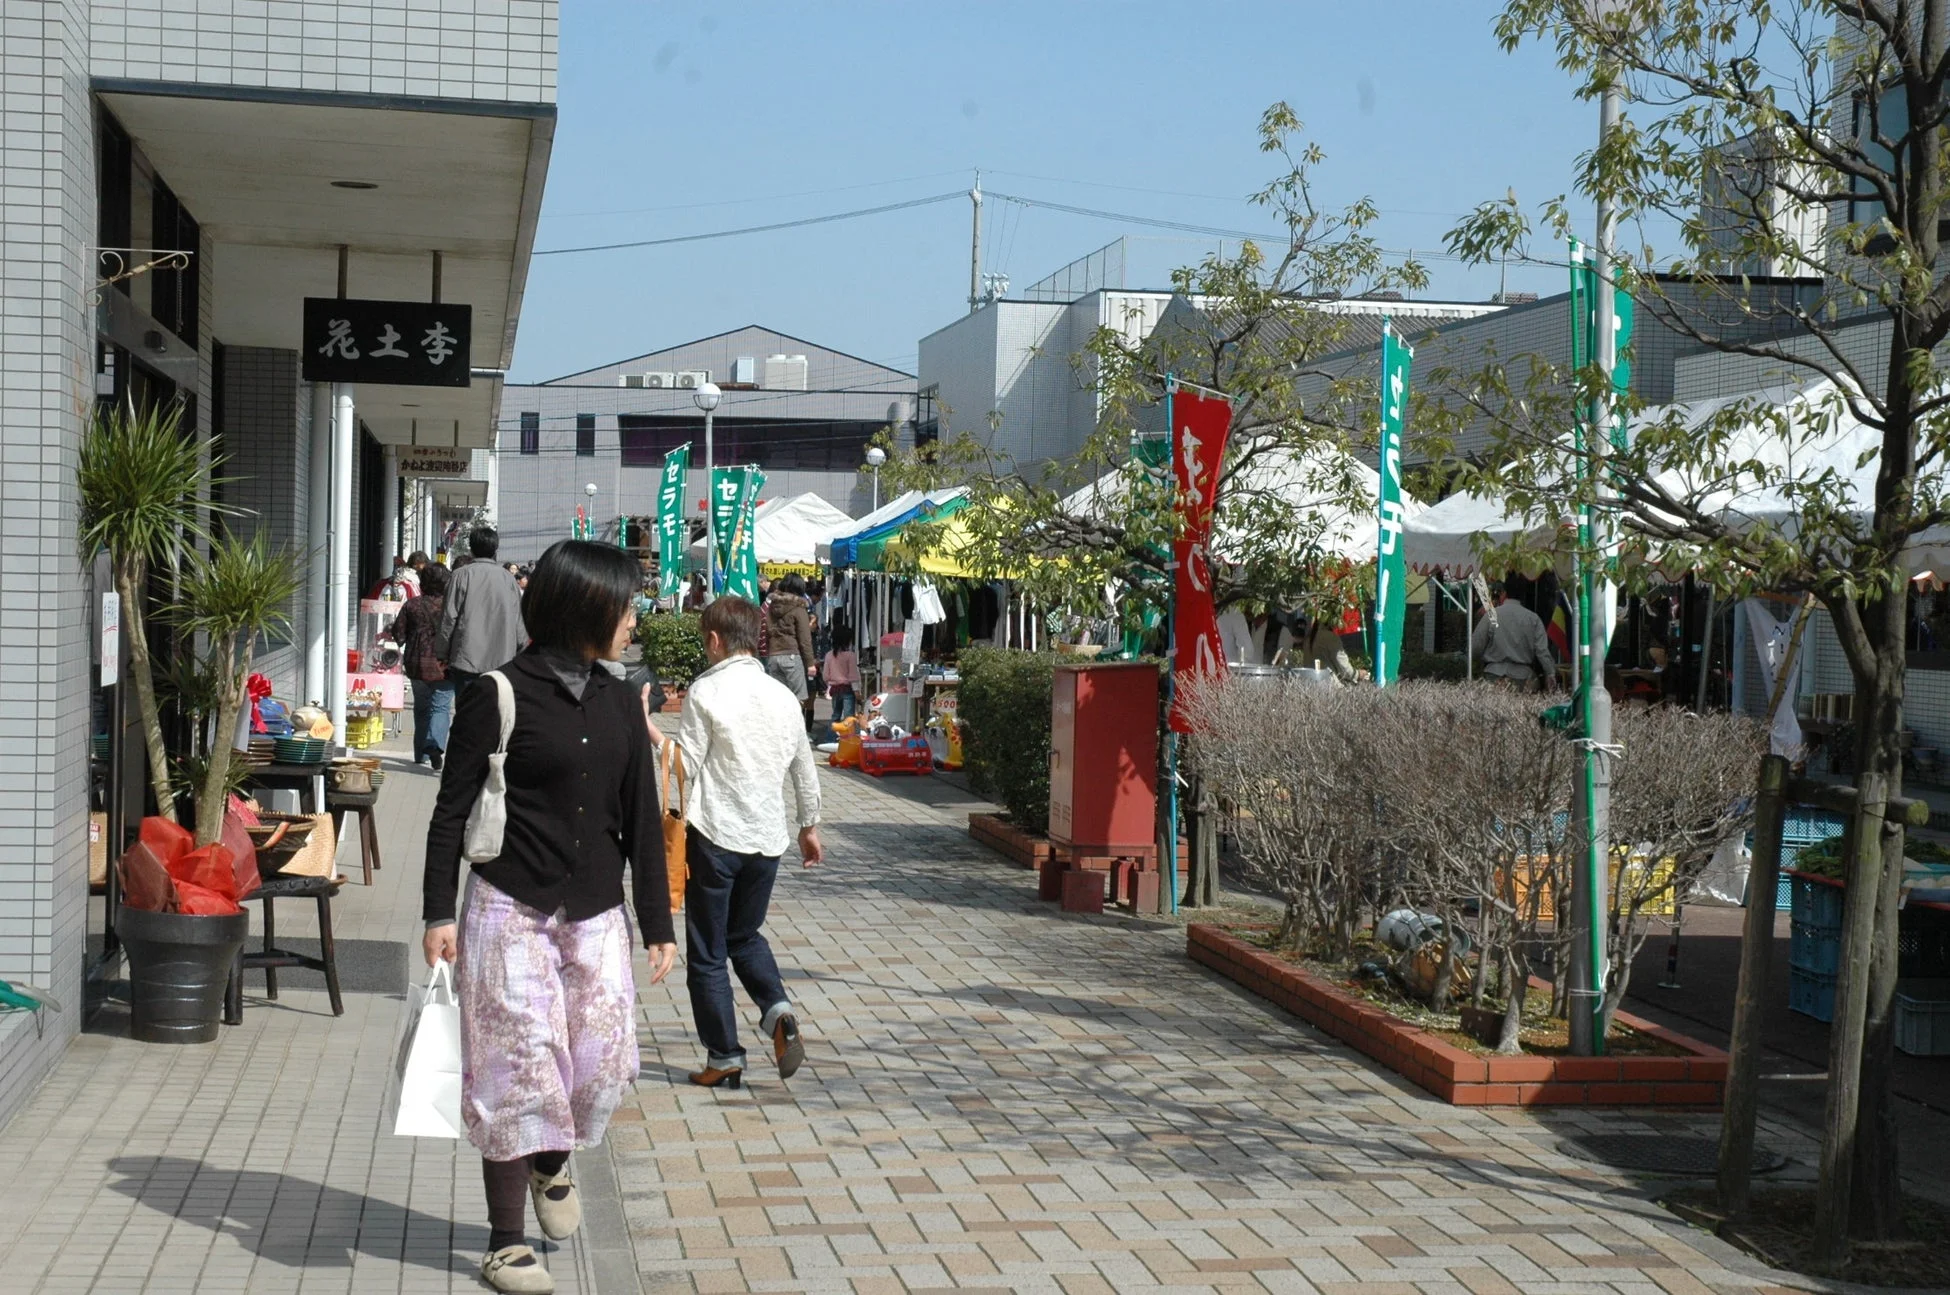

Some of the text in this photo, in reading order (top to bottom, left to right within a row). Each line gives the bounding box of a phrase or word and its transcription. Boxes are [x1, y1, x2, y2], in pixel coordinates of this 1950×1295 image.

[318, 319, 458, 365] 花土李
[662, 461, 680, 590] セラモール
